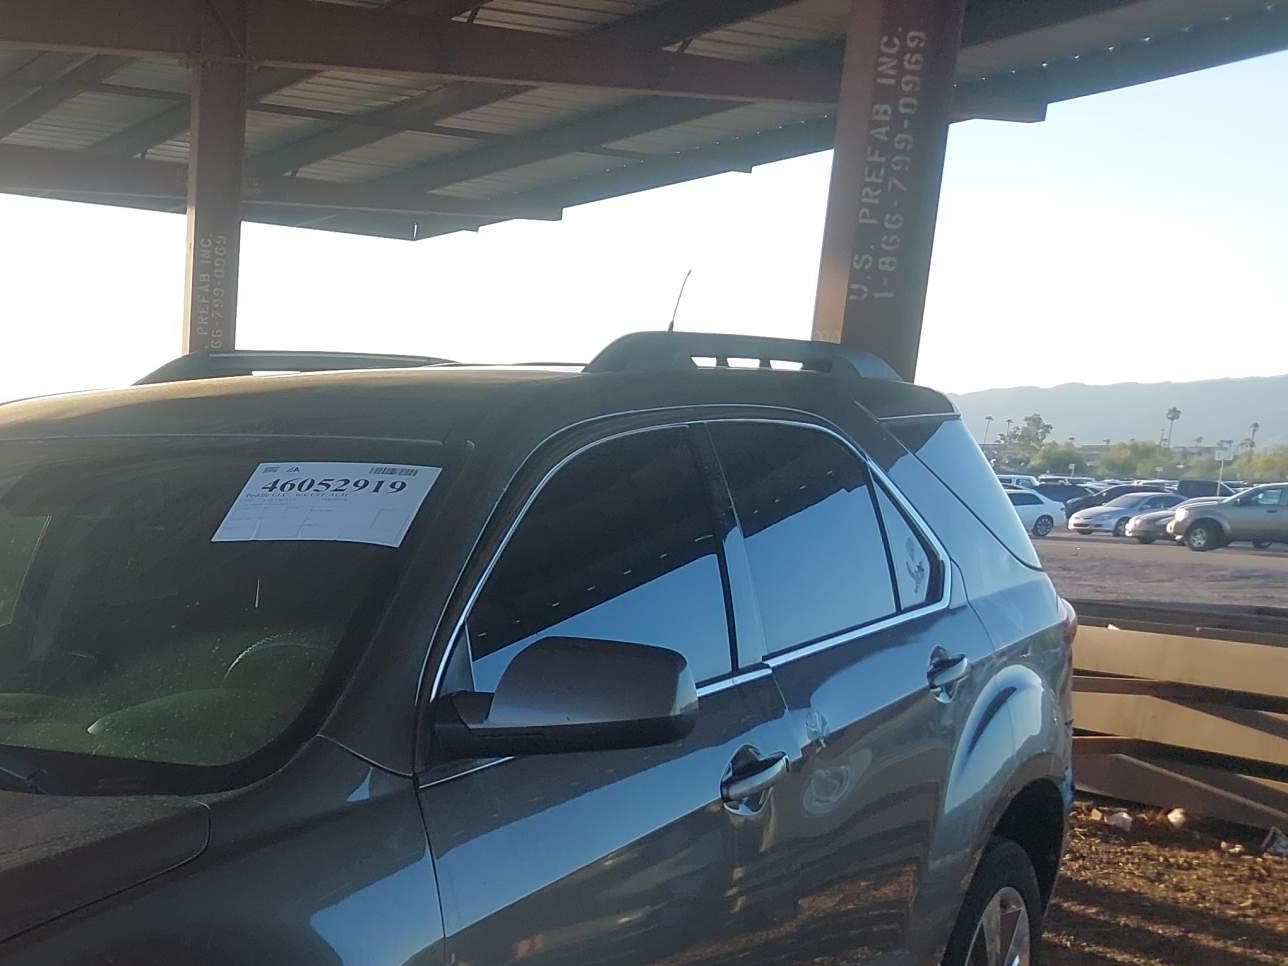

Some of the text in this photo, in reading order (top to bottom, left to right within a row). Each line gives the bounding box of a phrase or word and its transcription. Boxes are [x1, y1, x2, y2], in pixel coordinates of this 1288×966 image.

[849, 27, 903, 301] U.S. PREFAB INC.
[874, 31, 928, 300] 1-866-799-0969
[196, 272, 211, 336] PREFAB
[210, 235, 227, 349] 66-799-0969
[262, 477, 407, 494] 46052919
